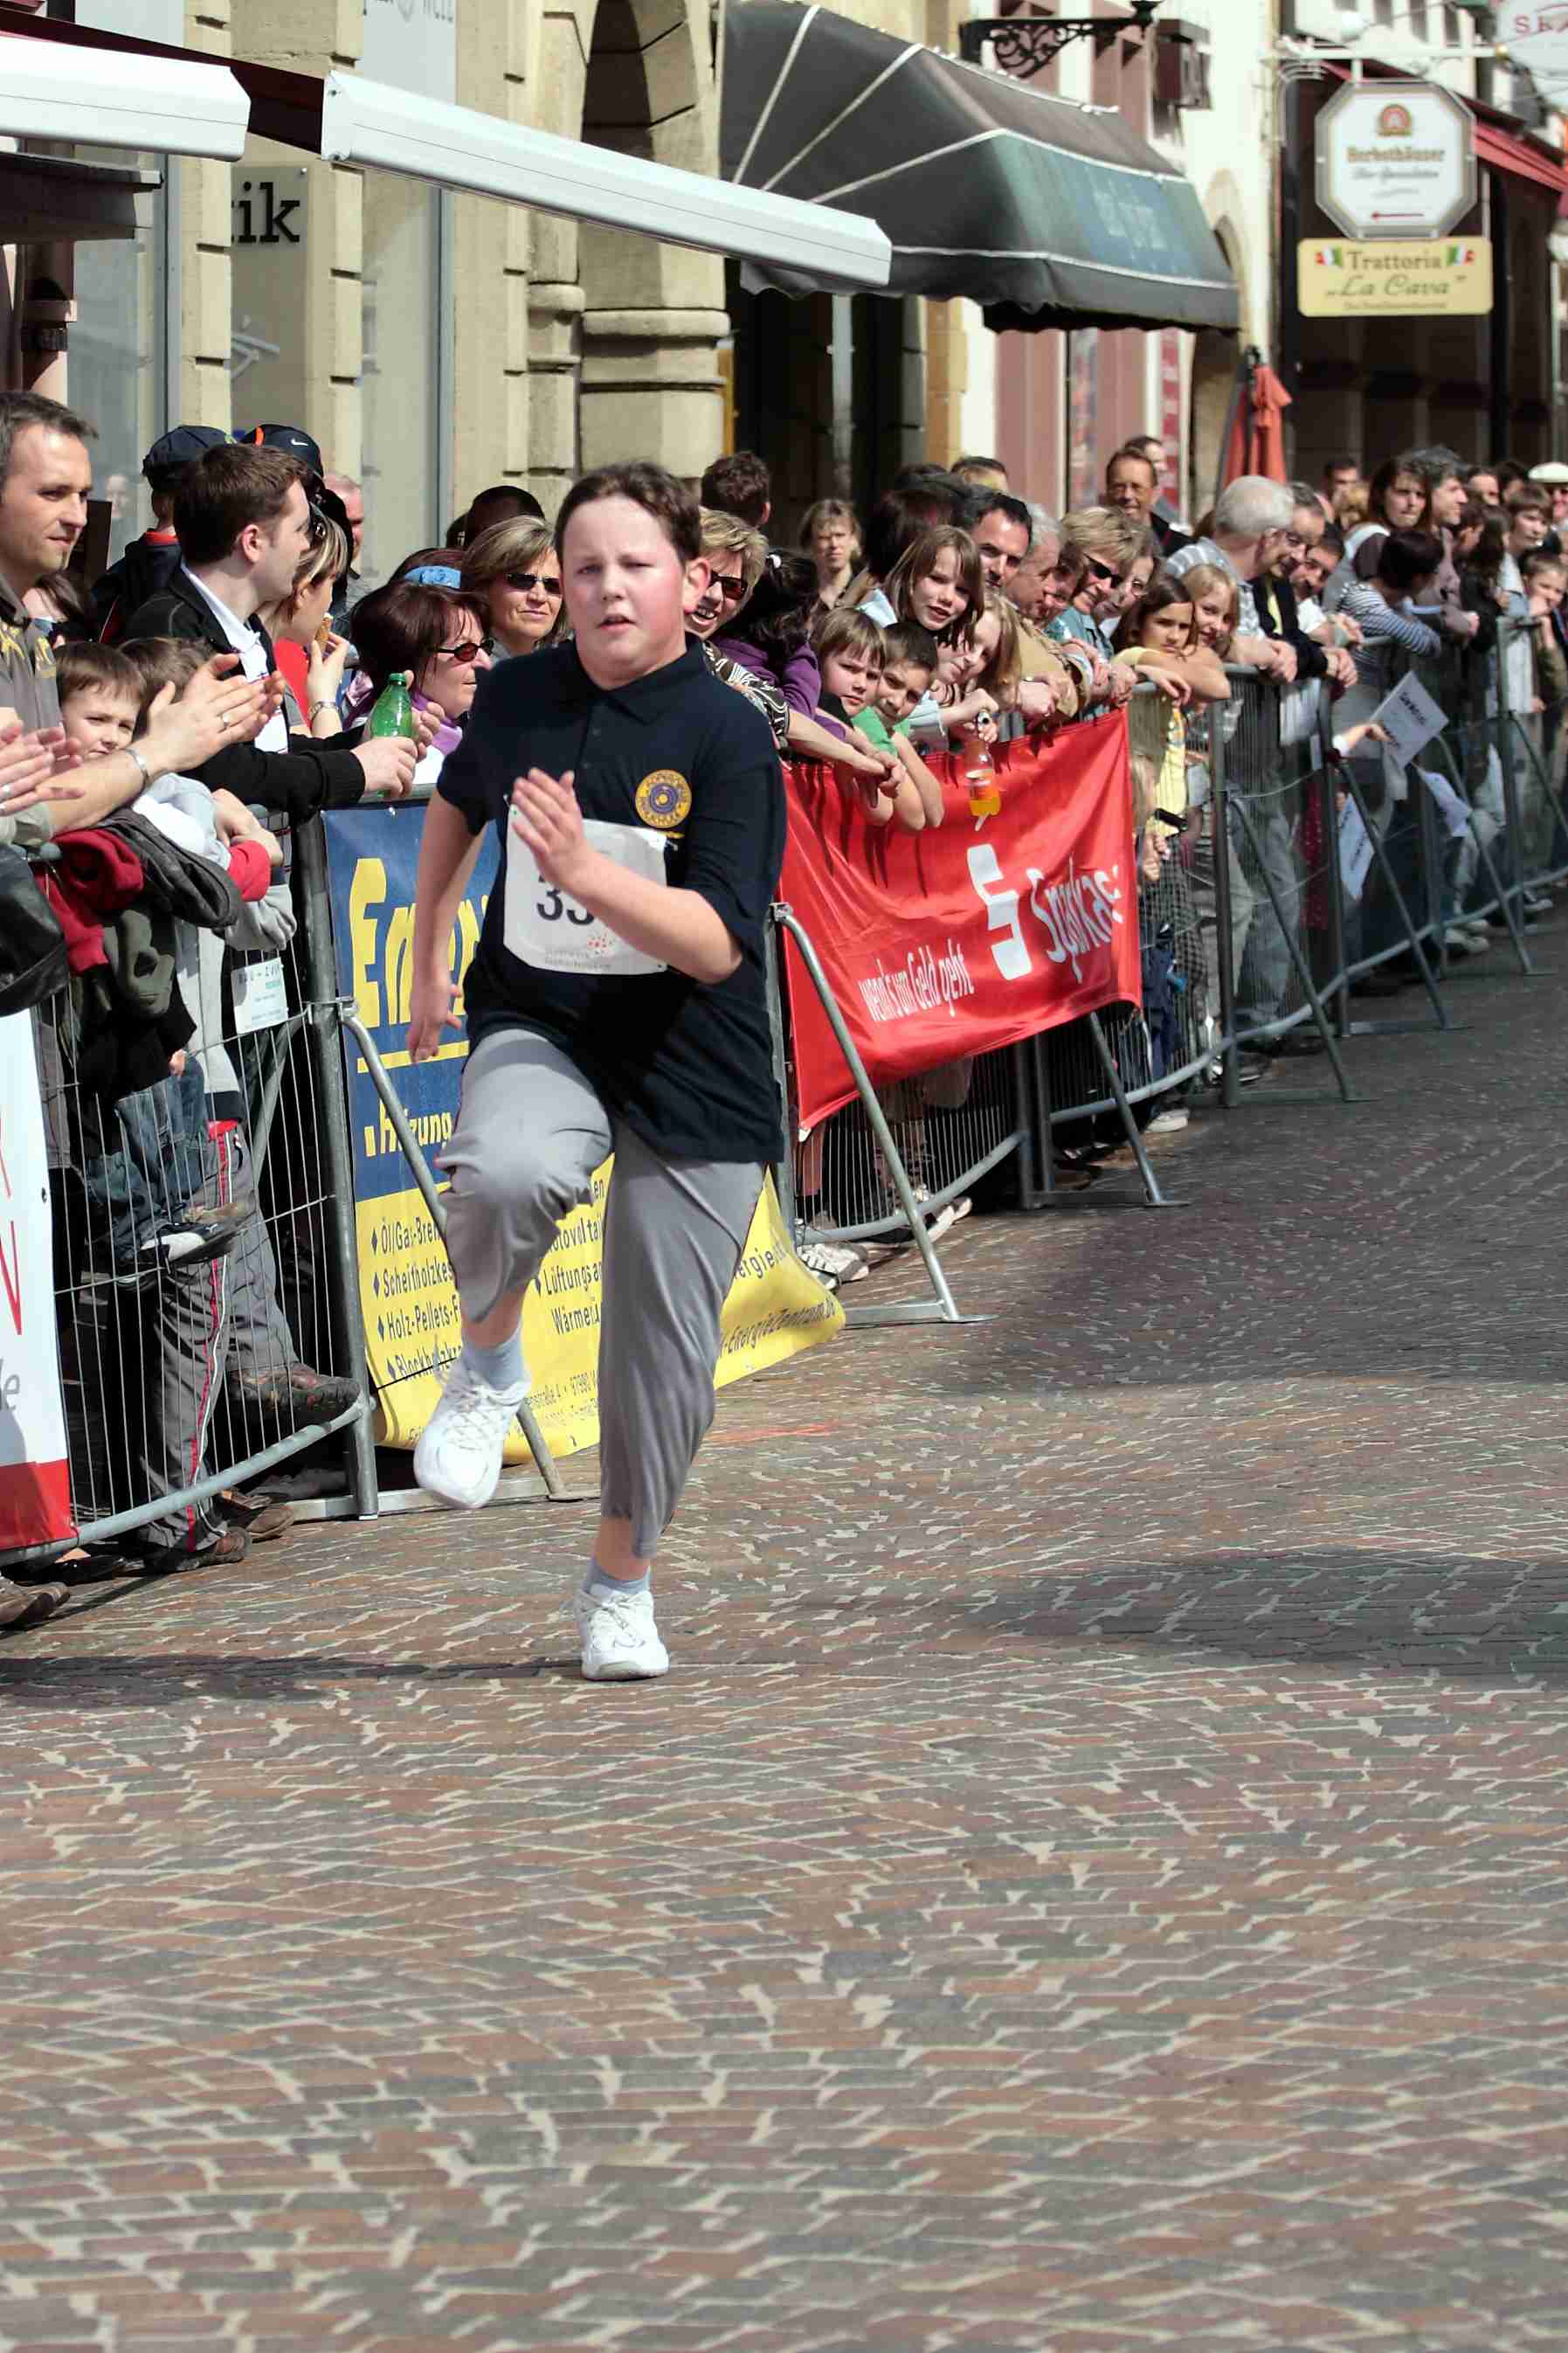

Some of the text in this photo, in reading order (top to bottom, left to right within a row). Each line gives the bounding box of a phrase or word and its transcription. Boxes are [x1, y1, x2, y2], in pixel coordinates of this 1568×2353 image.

[231, 181, 300, 243] ik
[1346, 250, 1442, 270] Trattoria
[908, 945, 942, 1010] Geld
[938, 938, 974, 1017] geht
